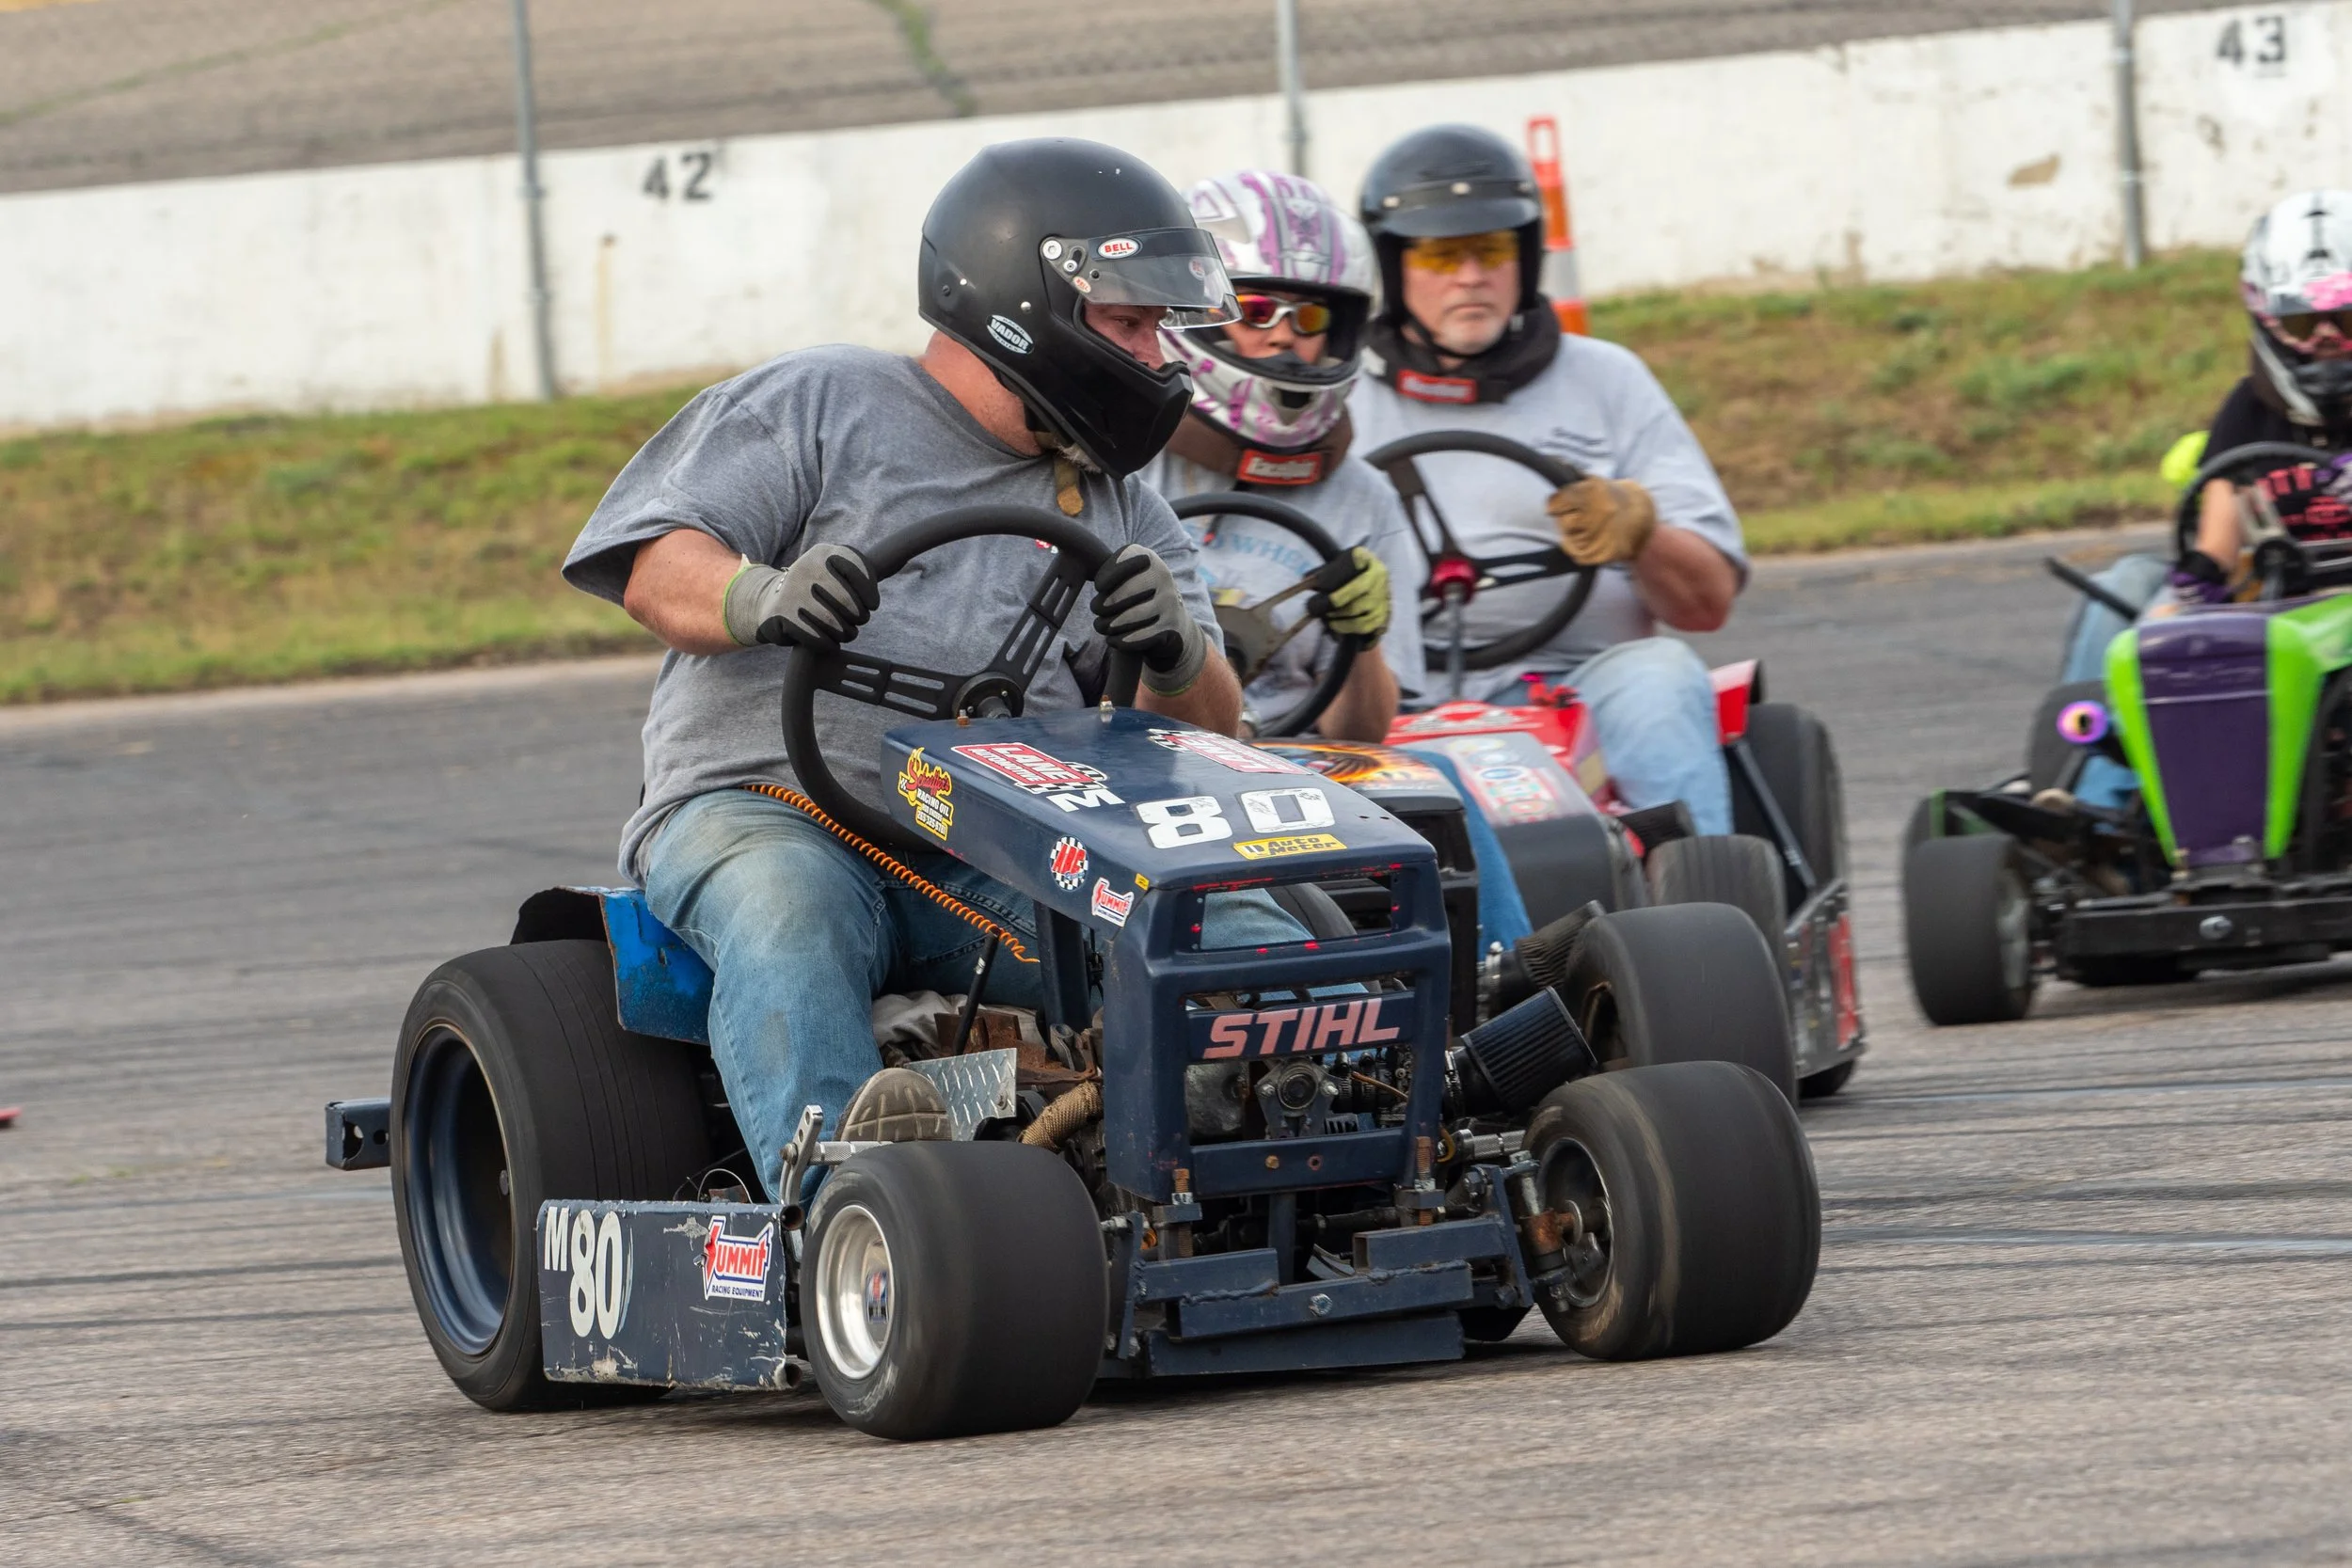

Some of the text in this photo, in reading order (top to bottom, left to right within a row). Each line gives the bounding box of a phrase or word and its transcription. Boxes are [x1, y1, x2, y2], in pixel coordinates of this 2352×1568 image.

[2217, 16, 2285, 68] 43
[643, 151, 712, 200] 42
[1104, 242, 1134, 253] BELL
[991, 318, 1029, 350] VADOR
[967, 748, 1047, 783] AUTOMOTIVE
[991, 747, 1082, 781] LANE
[917, 787, 950, 817] RACING OIL
[1136, 787, 1336, 849] 80
[1268, 836, 1320, 848] Auto
[1269, 841, 1338, 856] Meter
[1203, 997, 1400, 1059] STIHL
[711, 1284, 764, 1298] RACING EQUIPMENT
